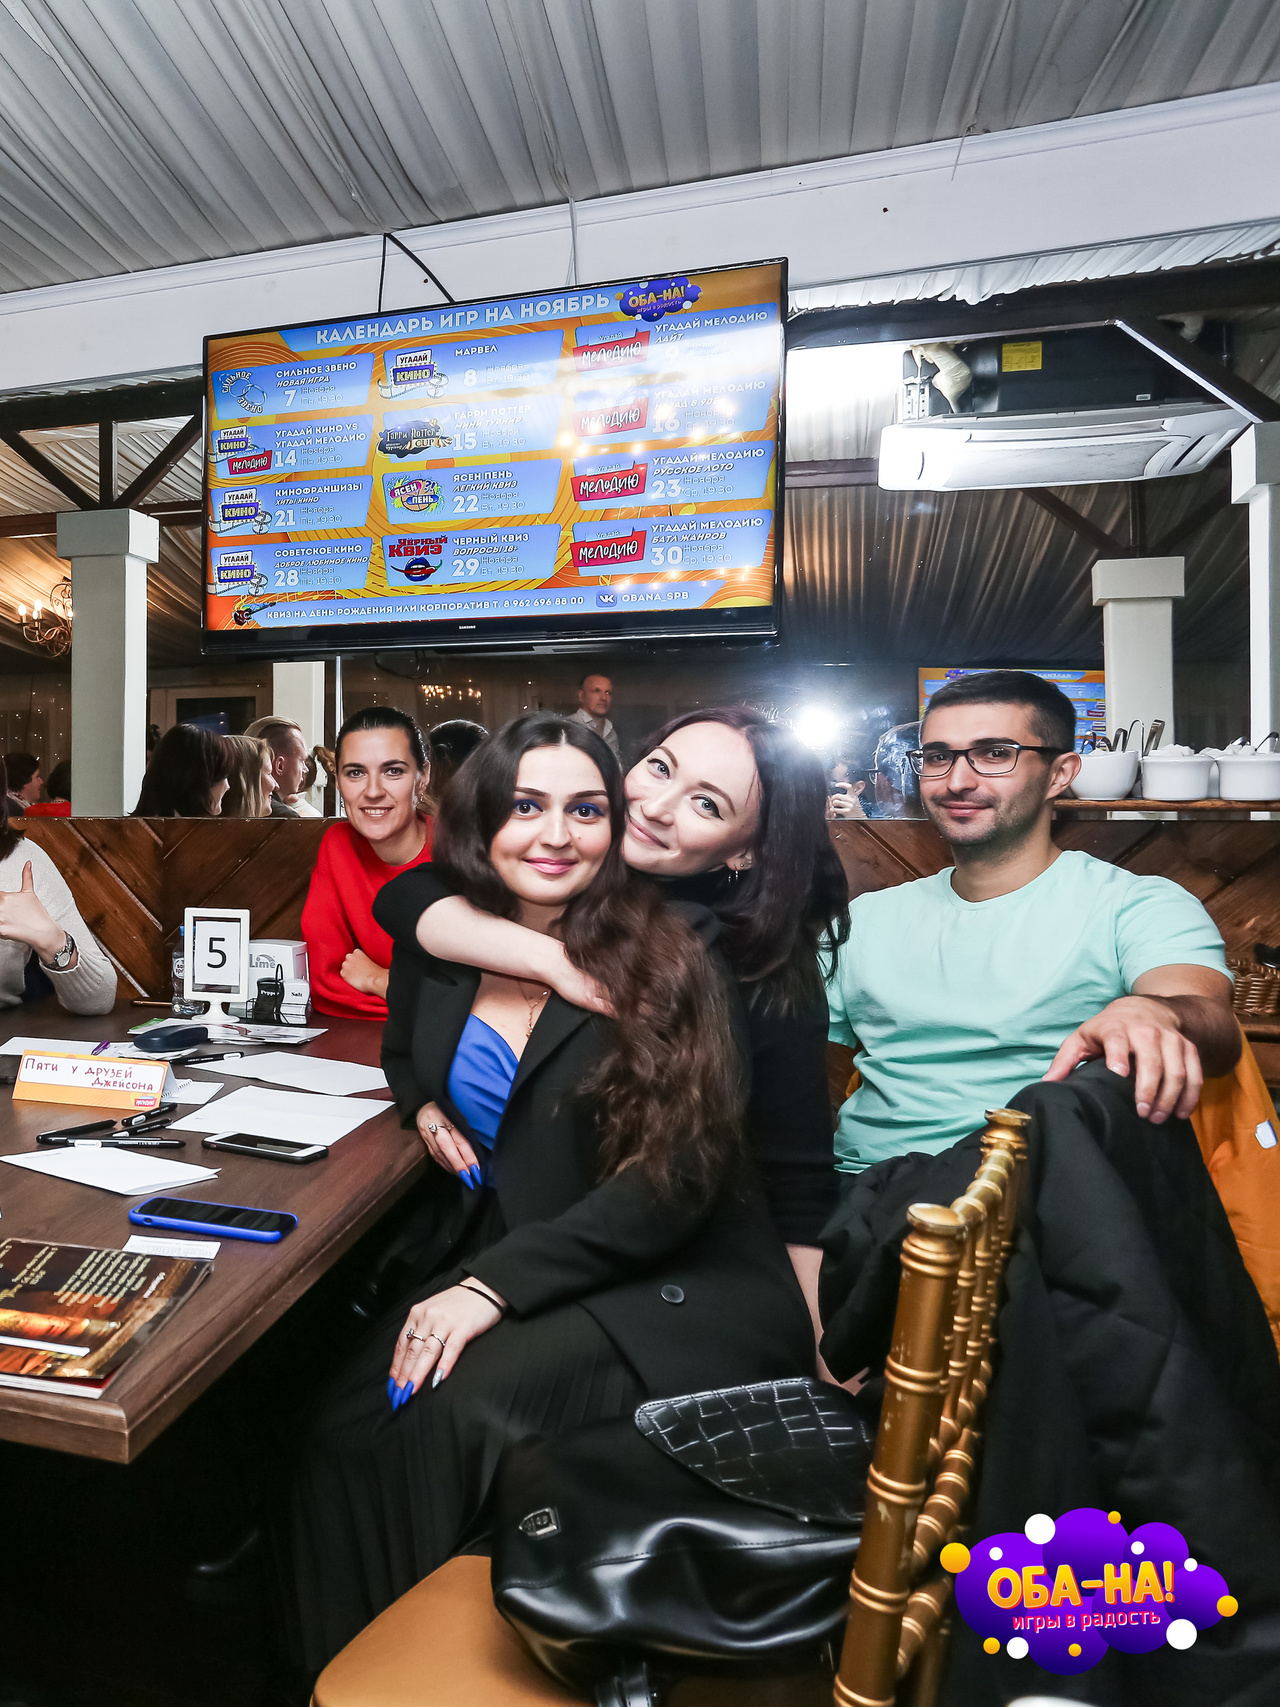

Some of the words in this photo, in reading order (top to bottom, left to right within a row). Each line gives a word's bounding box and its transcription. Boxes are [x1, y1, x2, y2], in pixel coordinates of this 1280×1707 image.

[629, 286, 685, 308] ОБА-НА!
[316, 316, 433, 345] КАЛЕНДАРЬ
[440, 309, 479, 329] ИГР
[485, 303, 514, 324] НА
[520, 292, 610, 318] НОЯБРЬ
[654, 318, 702, 333] УГАДАЙ
[704, 311, 768, 327] МЕЛОДИЮ
[655, 332, 684, 344] ЛАЙТ
[400, 351, 428, 364] УГАДАЙ
[455, 345, 498, 357] МАРВЕЛ
[276, 365, 322, 378] СИЛЬНОЕ
[324, 362, 357, 373] ЗВЕНО
[396, 368, 431, 383] КИНО
[464, 368, 477, 386] 8
[222, 371, 252, 394] СИЛЬНОЕ
[276, 379, 306, 388] НОВАЯ
[308, 375, 330, 384] ИГРА
[284, 389, 297, 407] 7
[301, 385, 335, 395] Ноября
[654, 386, 699, 399] УГАДАЙ
[702, 381, 766, 395] МЕЛОДИЮ
[237, 397, 263, 413] ЗВЕНО
[454, 409, 487, 420] ГАРРИ
[492, 405, 531, 416] ПОТТЕР
[454, 420, 481, 430] МИНИ
[486, 417, 522, 427] ТУРНИР
[652, 411, 680, 432] 16
[223, 428, 244, 437] УГАДАЙ
[275, 427, 315, 438] УГАДАЙ
[318, 424, 343, 435] КИНО
[345, 422, 358, 432] VS
[220, 440, 246, 451] КИНО
[275, 436, 312, 448] УГАДАЙ
[315, 432, 366, 446] МЕЛОДИЮ
[415, 438, 435, 448] CUP
[452, 433, 477, 450] 15
[274, 451, 297, 468] 14
[300, 446, 335, 455] Ноября
[652, 453, 698, 466] УГАДАЙ
[701, 448, 765, 462] МЕЛОДИЮ
[653, 464, 702, 476] РУССКОЕ
[704, 462, 734, 472] ЛОТО
[453, 473, 481, 482] ЯСЕН
[484, 471, 513, 480] ПЕНЬ
[275, 483, 363, 497] КИНОФРАНШИЗЫ
[394, 483, 418, 497] ЯСЕН
[453, 481, 491, 493] ЛЕГКИЙ
[492, 480, 518, 489] КВИЗ
[651, 480, 681, 499] 23
[684, 475, 725, 486] Ноября
[702, 484, 734, 495] 19:30
[227, 491, 253, 501] УГАДАЙ
[275, 498, 296, 506] ХИТЫ
[298, 496, 319, 504] КИНО
[412, 495, 434, 504] ПЕНЬ
[452, 494, 479, 513] 22
[481, 492, 518, 500] Ноября
[224, 505, 256, 518] КИНО
[274, 510, 296, 526] 21
[300, 506, 334, 515] Ноября
[651, 520, 698, 533] УГАДАЙ
[700, 517, 764, 530] МЕЛОДИЮ
[453, 534, 498, 545] ЧЕРНЫЙ
[501, 533, 529, 542] КВИЗ
[652, 534, 679, 544] БАТЛ
[680, 531, 727, 542] ЖАНРОВ
[274, 547, 332, 558] СОВЕТСКОЕ
[334, 544, 362, 553] КИНО
[389, 544, 442, 557] КВИЗ
[453, 546, 503, 556] ВОПРОСЫ
[504, 545, 518, 553] 18+
[651, 546, 683, 566] 30
[684, 543, 724, 553] Ноября
[223, 554, 249, 563] УГАДАЙ
[274, 560, 305, 569] ДОБРОЕ
[307, 558, 345, 566] ЛЮБИМОЕ
[346, 556, 369, 564] КИНО
[701, 553, 732, 563] 19:30
[452, 558, 480, 577] 29
[481, 555, 518, 564] Ноября
[220, 567, 252, 580] КИНО
[274, 569, 299, 587] 28
[300, 568, 334, 576] Ноября
[621, 591, 689, 602] OBANA_SPB
[267, 610, 294, 619] КВИЗ
[296, 609, 308, 618] НА
[309, 608, 333, 618] ДЕНЬ
[337, 605, 393, 616] РОЖДЕНИЯ
[395, 603, 417, 613] ИЛИ
[420, 600, 490, 613] КОРПОРАТИВ
[504, 599, 511, 608] 8
[513, 598, 531, 607] 962
[534, 597, 553, 606] 696
[555, 597, 568, 605] 88
[570, 596, 584, 605] 00
[207, 937, 227, 968] 5
[249, 954, 276, 969] Lime
